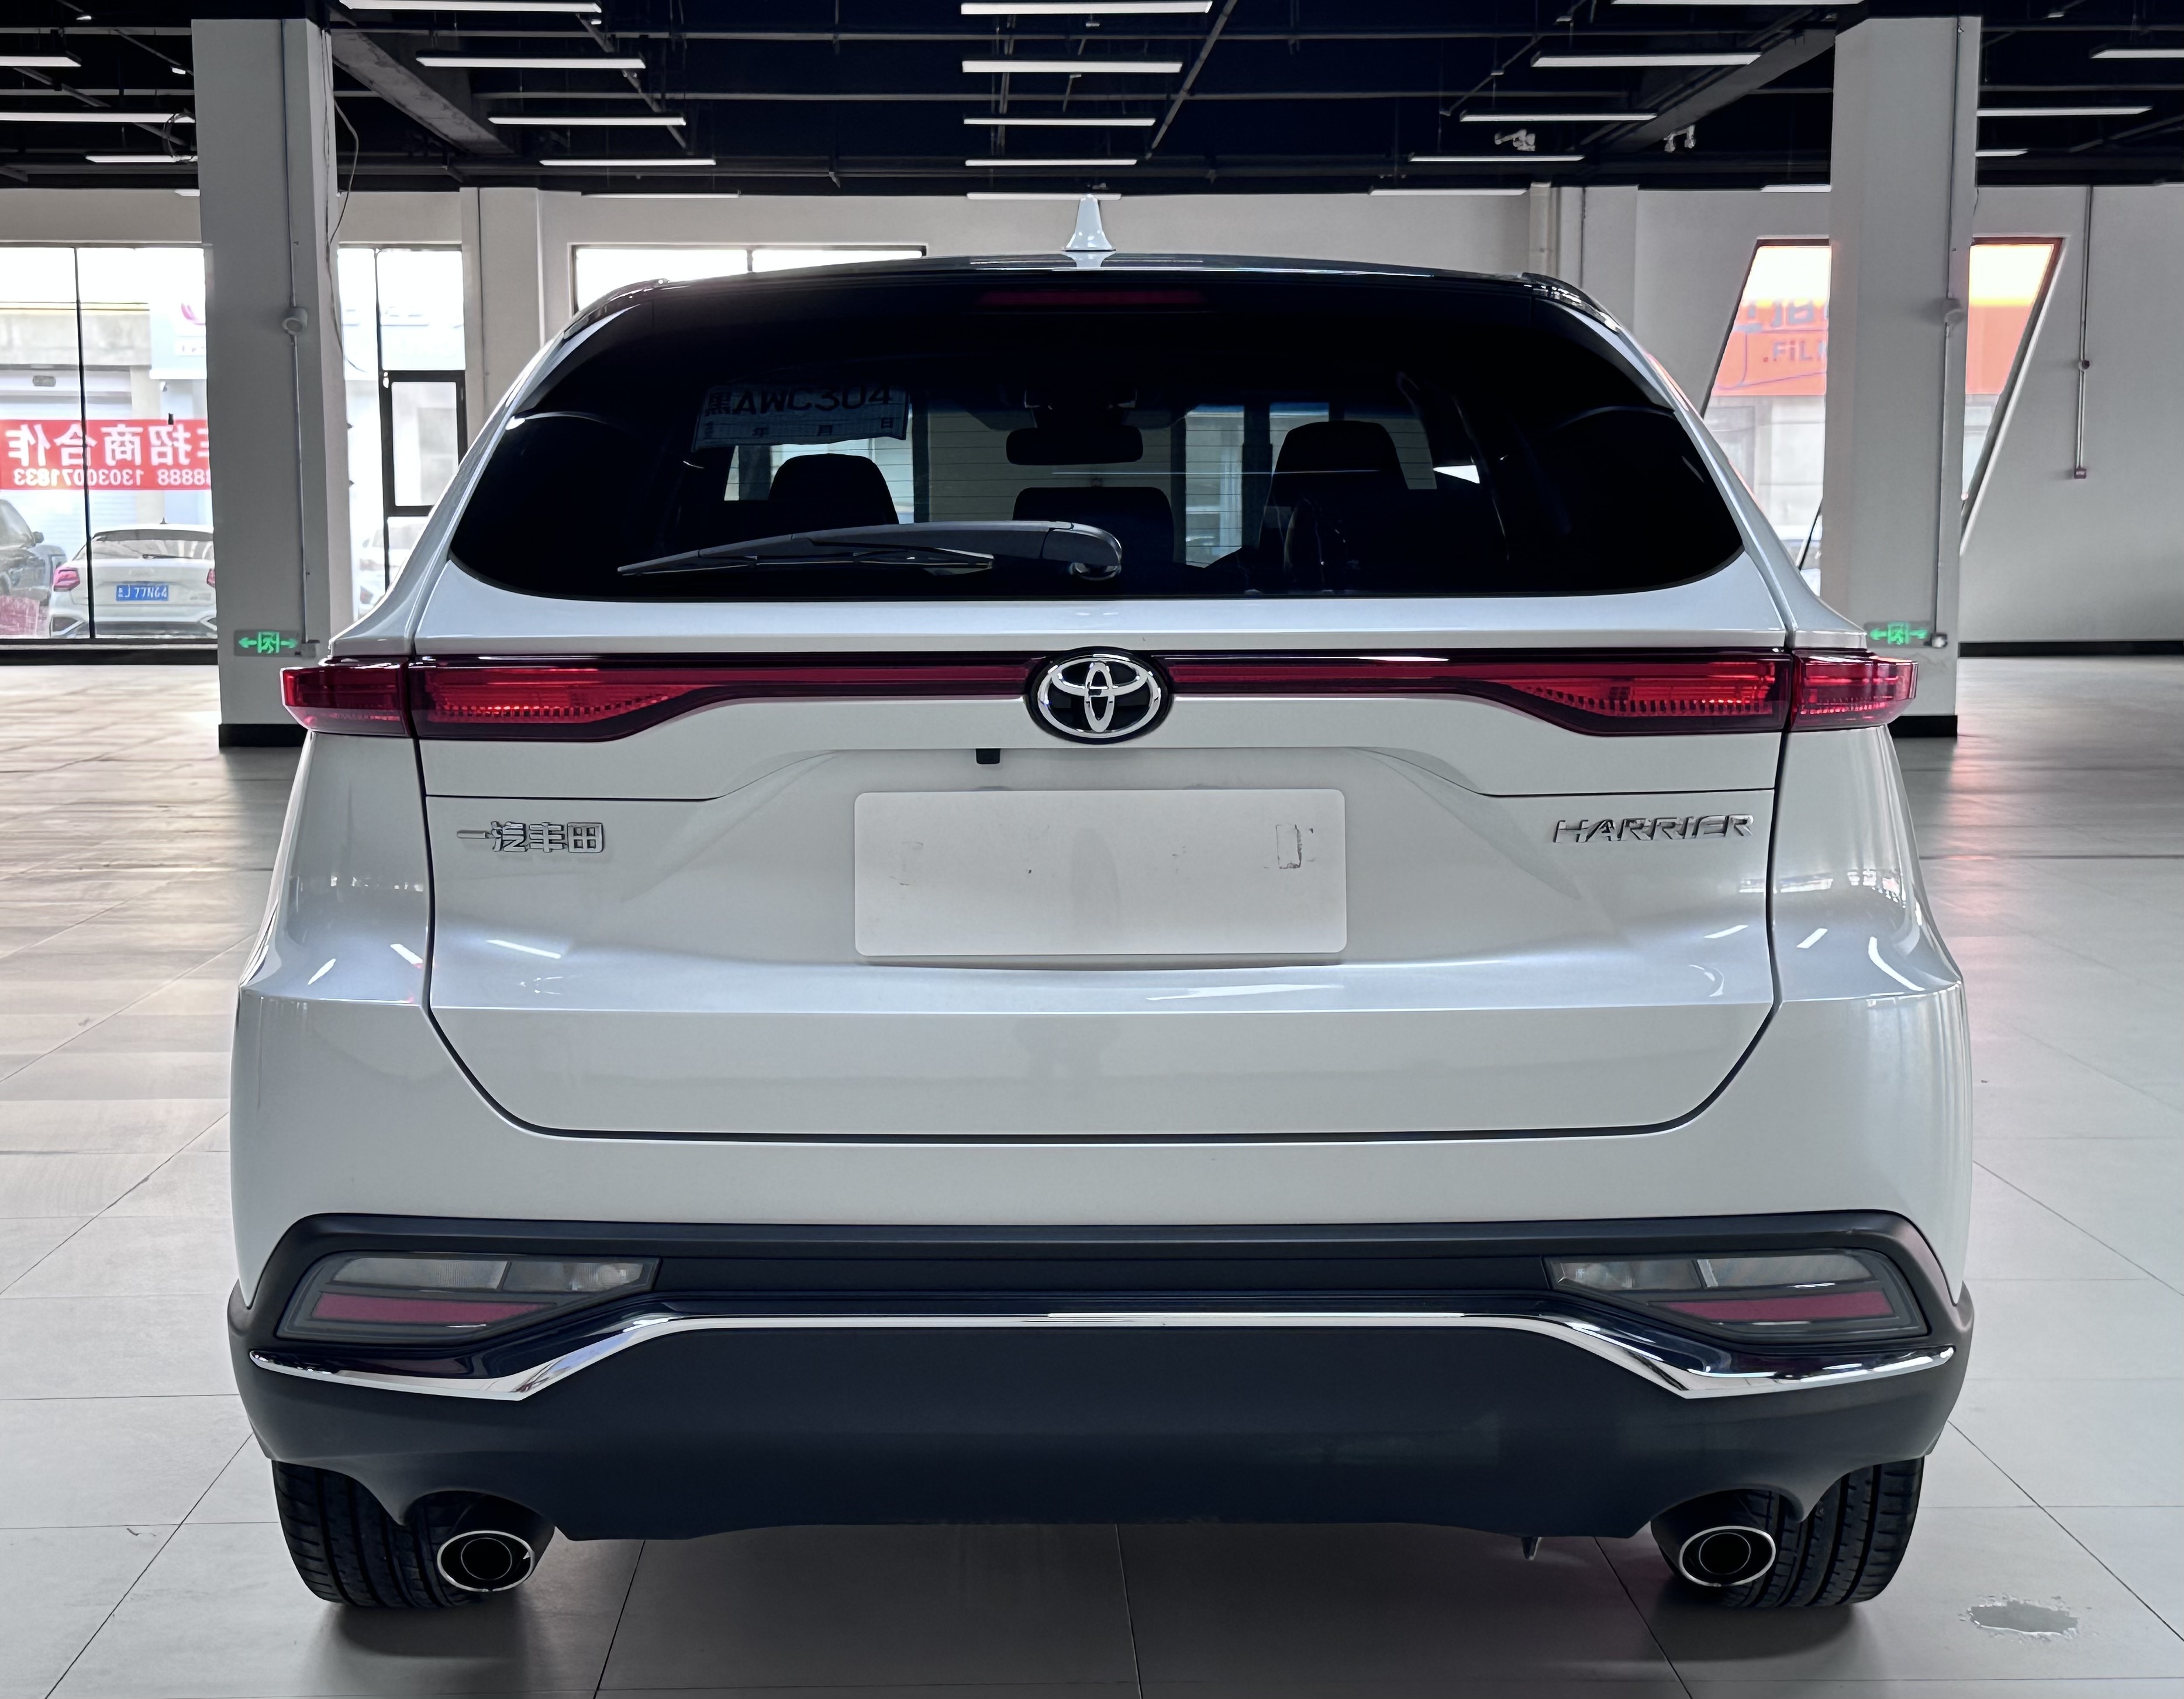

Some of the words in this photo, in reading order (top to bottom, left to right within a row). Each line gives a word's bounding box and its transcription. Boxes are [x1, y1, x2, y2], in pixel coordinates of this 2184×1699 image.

[457, 821, 604, 853] 一汽丰田
[1553, 814, 1754, 843] HARRIER
